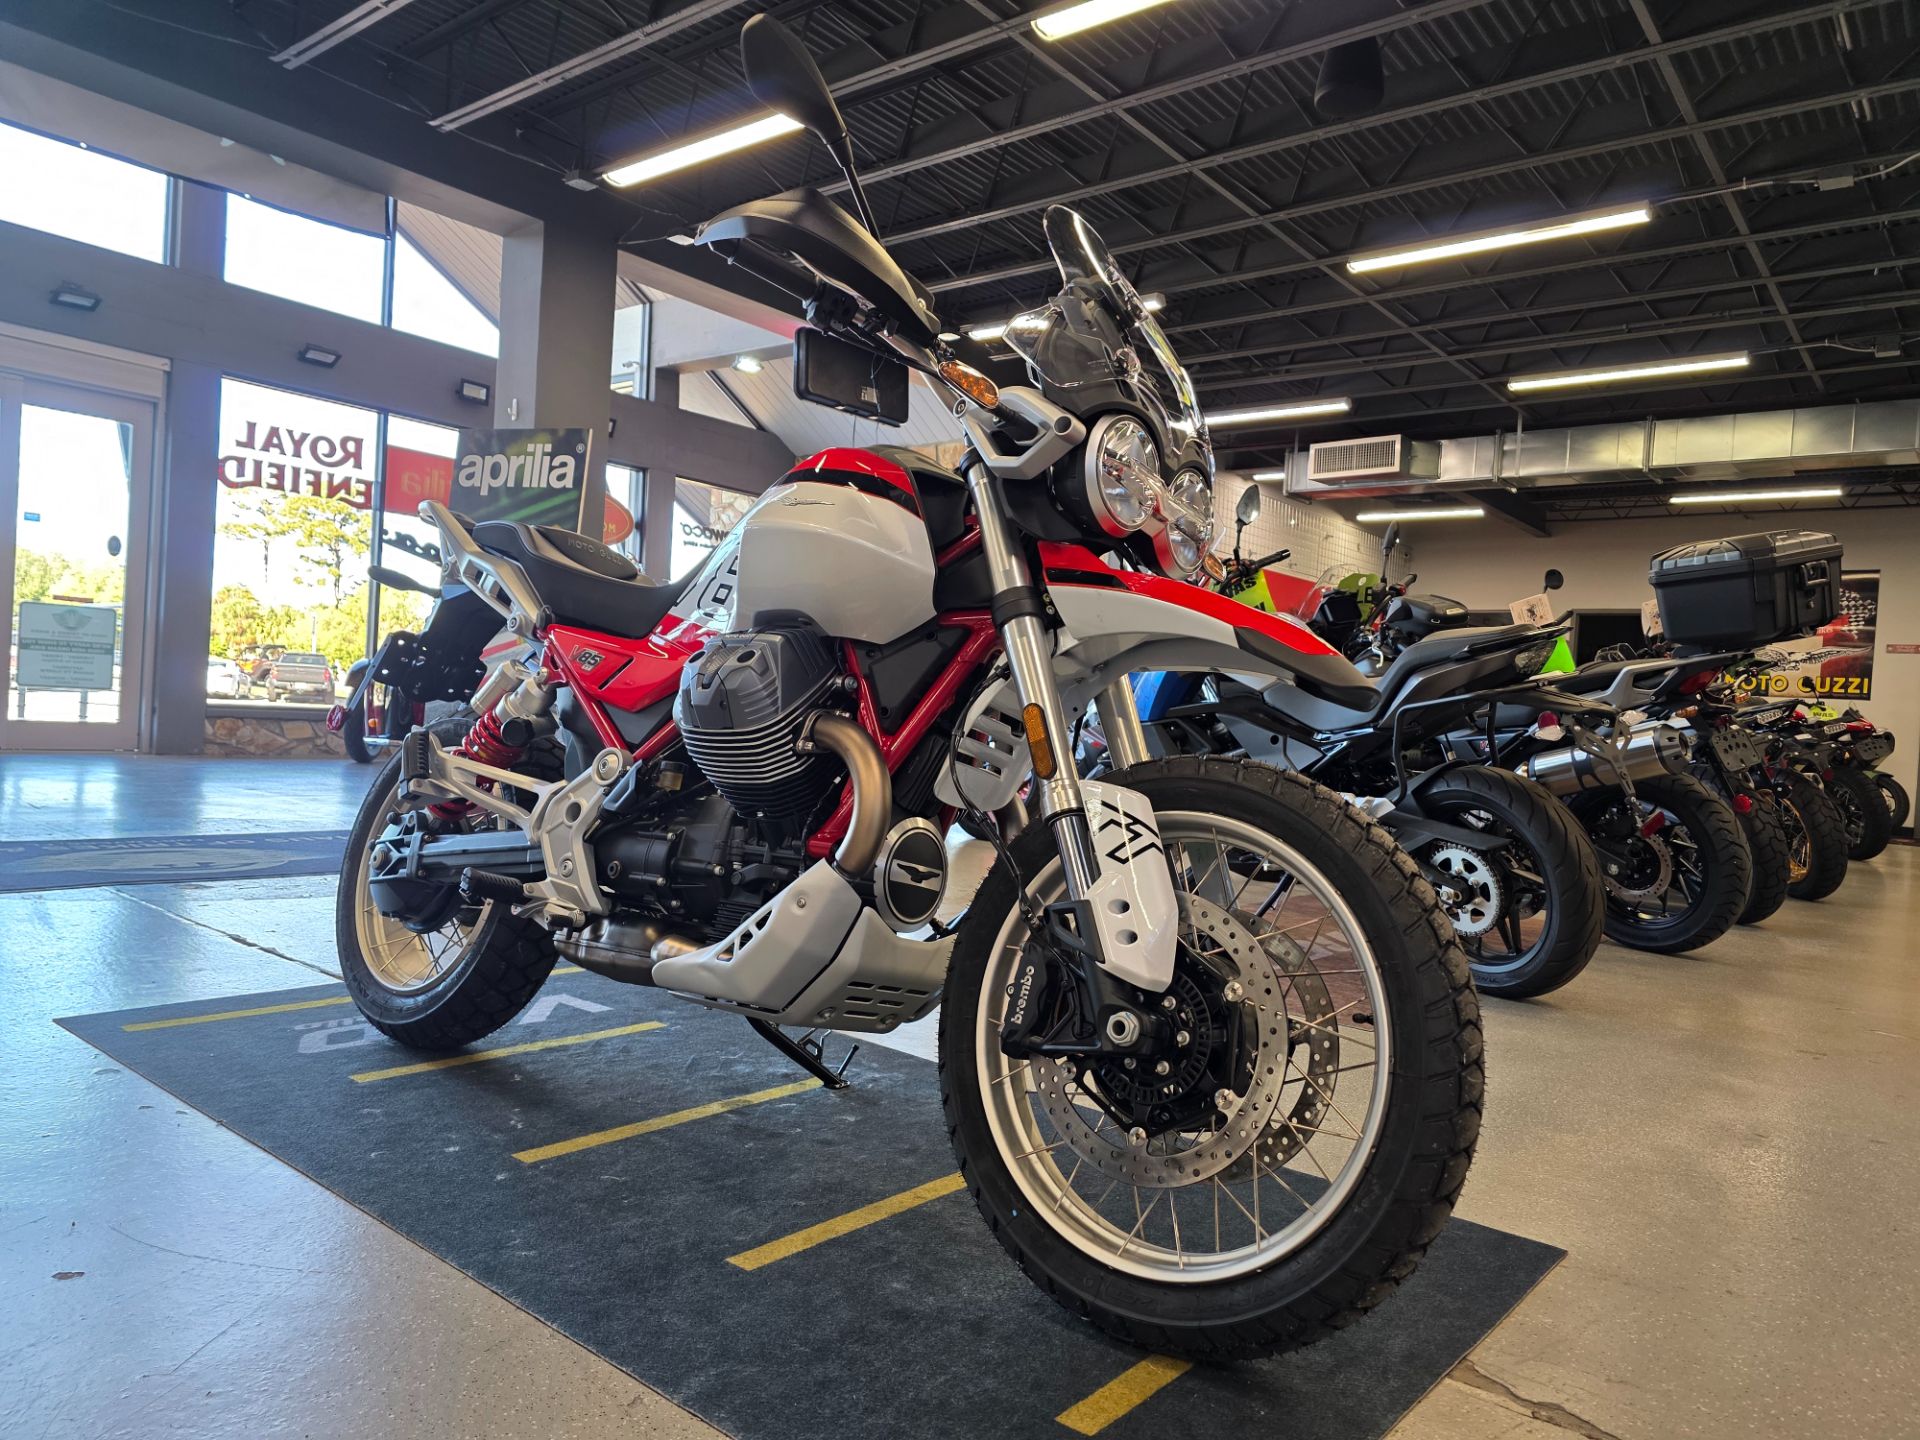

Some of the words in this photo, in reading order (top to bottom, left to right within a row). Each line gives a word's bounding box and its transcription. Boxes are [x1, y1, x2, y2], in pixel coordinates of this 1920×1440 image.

[458, 443, 576, 496] aprilia
[568, 644, 606, 668] V85
[1010, 965, 1035, 1025] brembo
